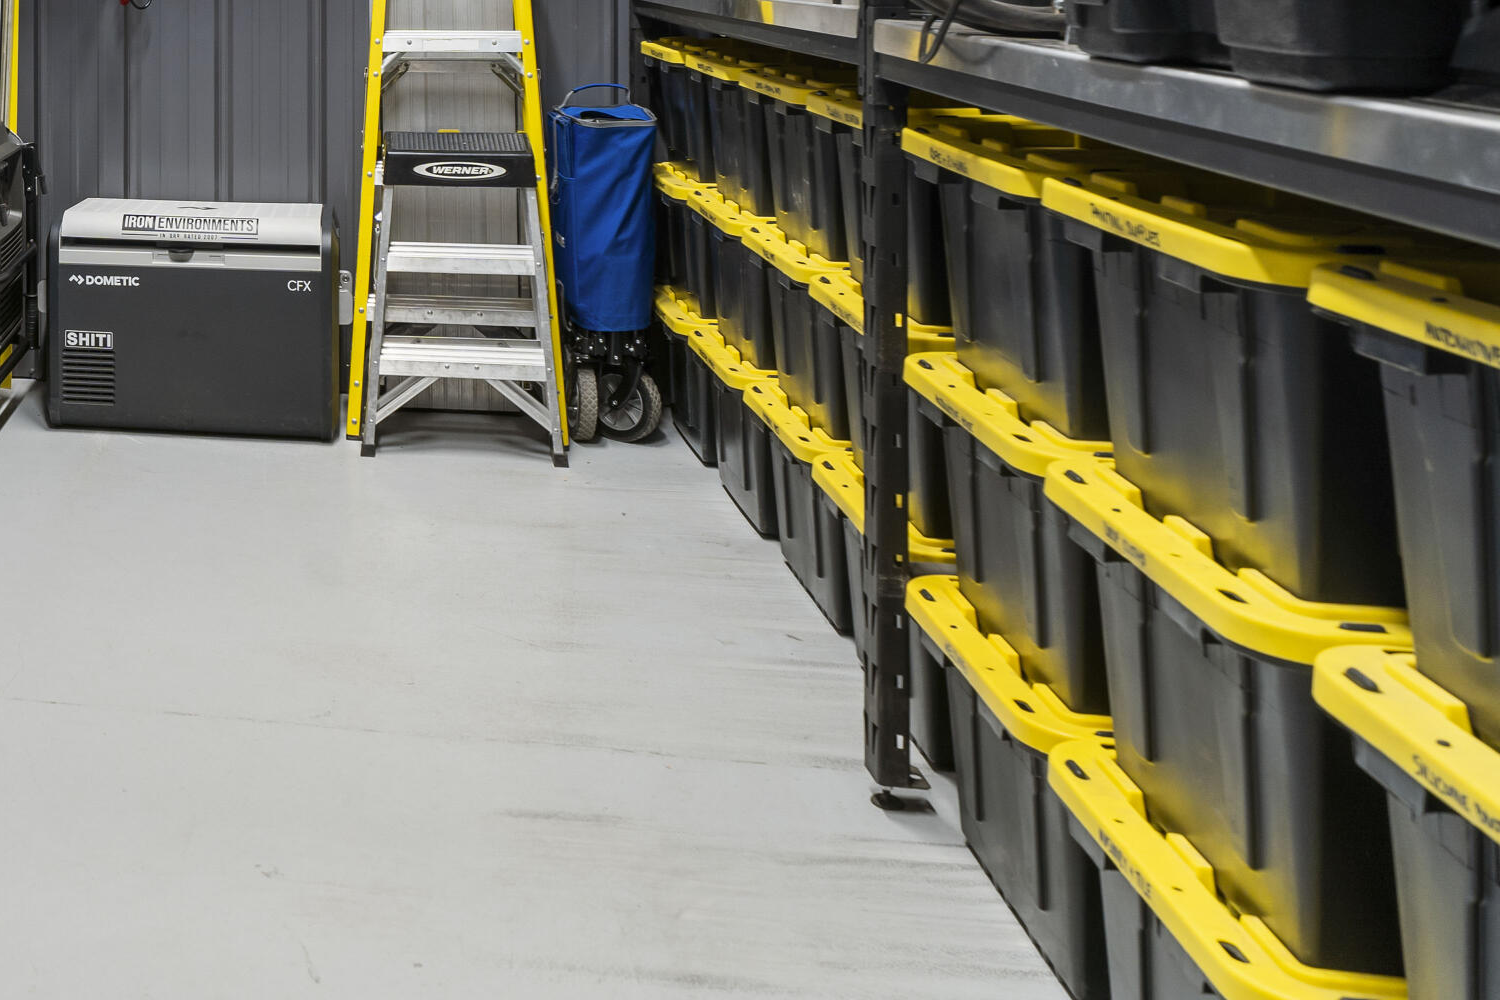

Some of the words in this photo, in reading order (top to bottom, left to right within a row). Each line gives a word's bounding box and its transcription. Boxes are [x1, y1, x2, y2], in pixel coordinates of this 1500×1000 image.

[432, 164, 489, 177] WERNER
[124, 216, 154, 229] IRON
[157, 217, 253, 232] ENVIRONMENTS
[85, 275, 140, 287] DOMETIC
[287, 280, 312, 293] CFX
